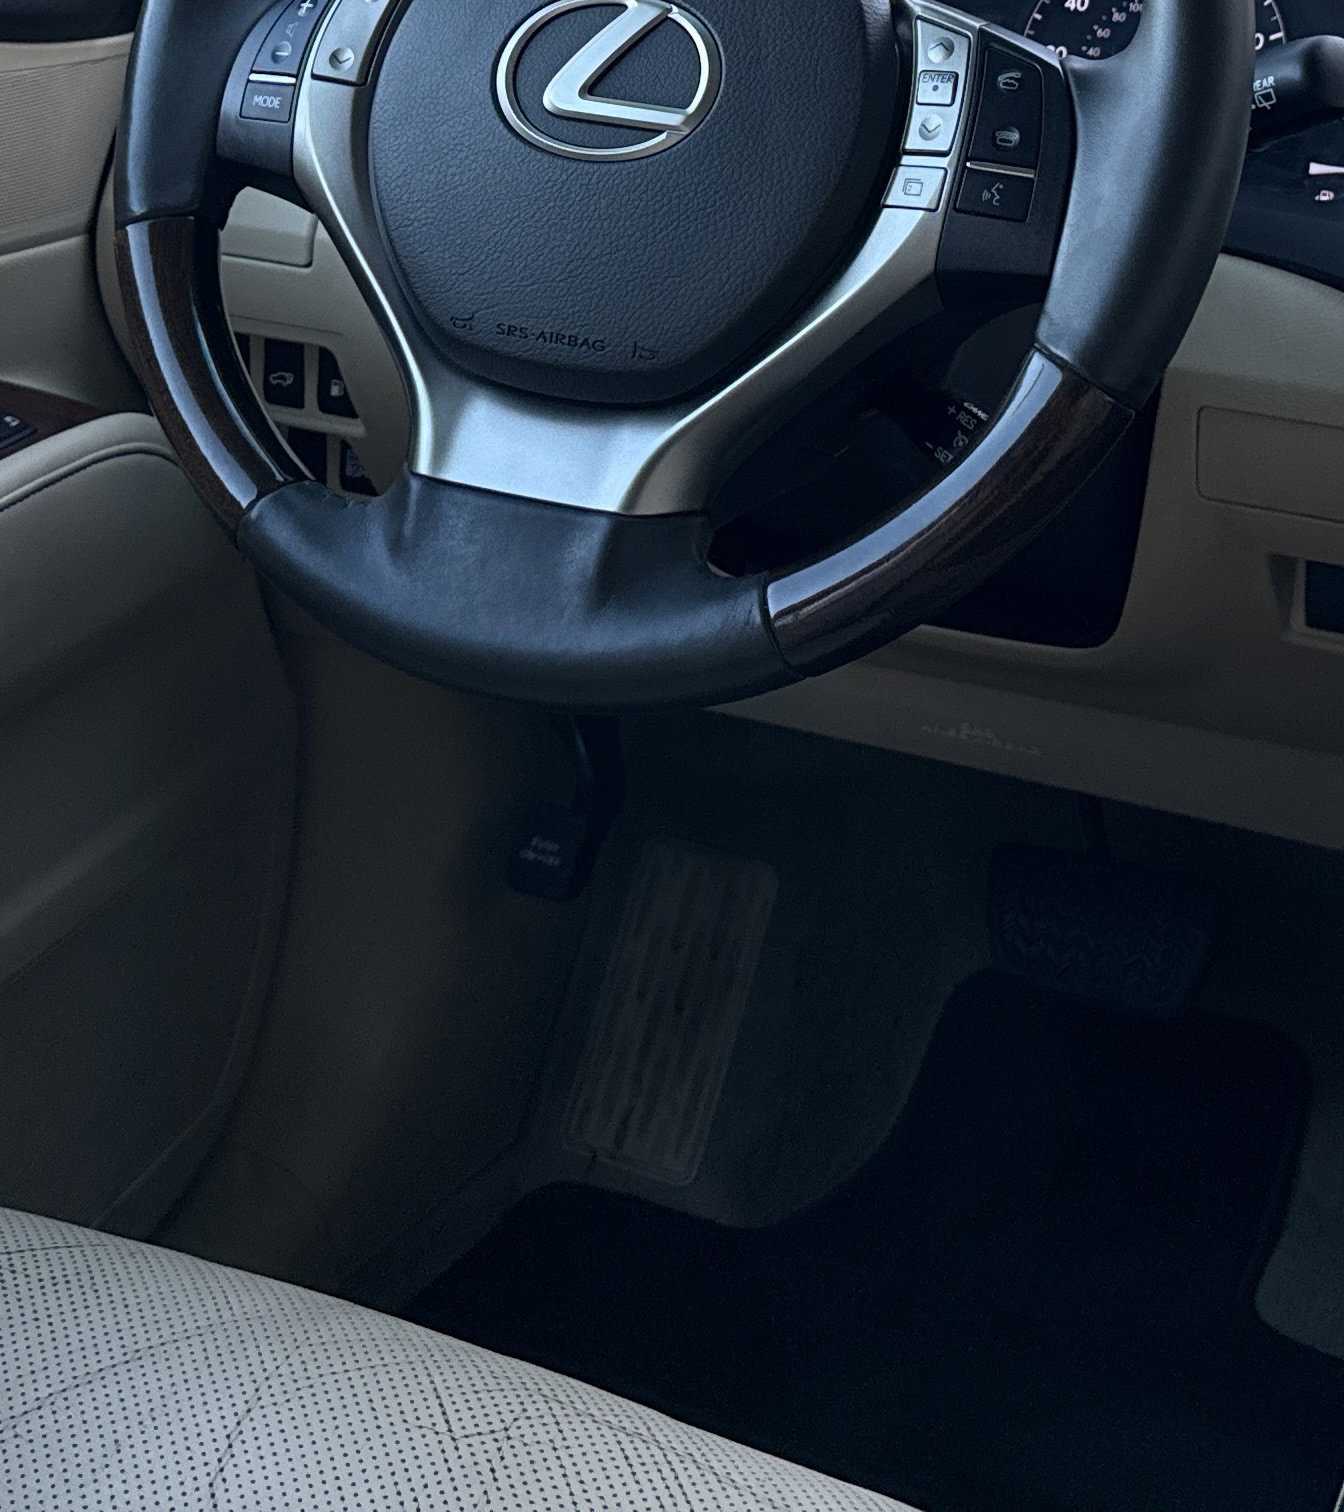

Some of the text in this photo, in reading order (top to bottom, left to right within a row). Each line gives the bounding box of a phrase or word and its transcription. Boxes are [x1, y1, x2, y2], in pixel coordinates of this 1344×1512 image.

[1111, 12, 1127, 22] 80
[1096, 28, 1112, 38] 60
[1087, 47, 1101, 57] 40
[921, 73, 955, 85] ENTER
[253, 95, 282, 109] MODE
